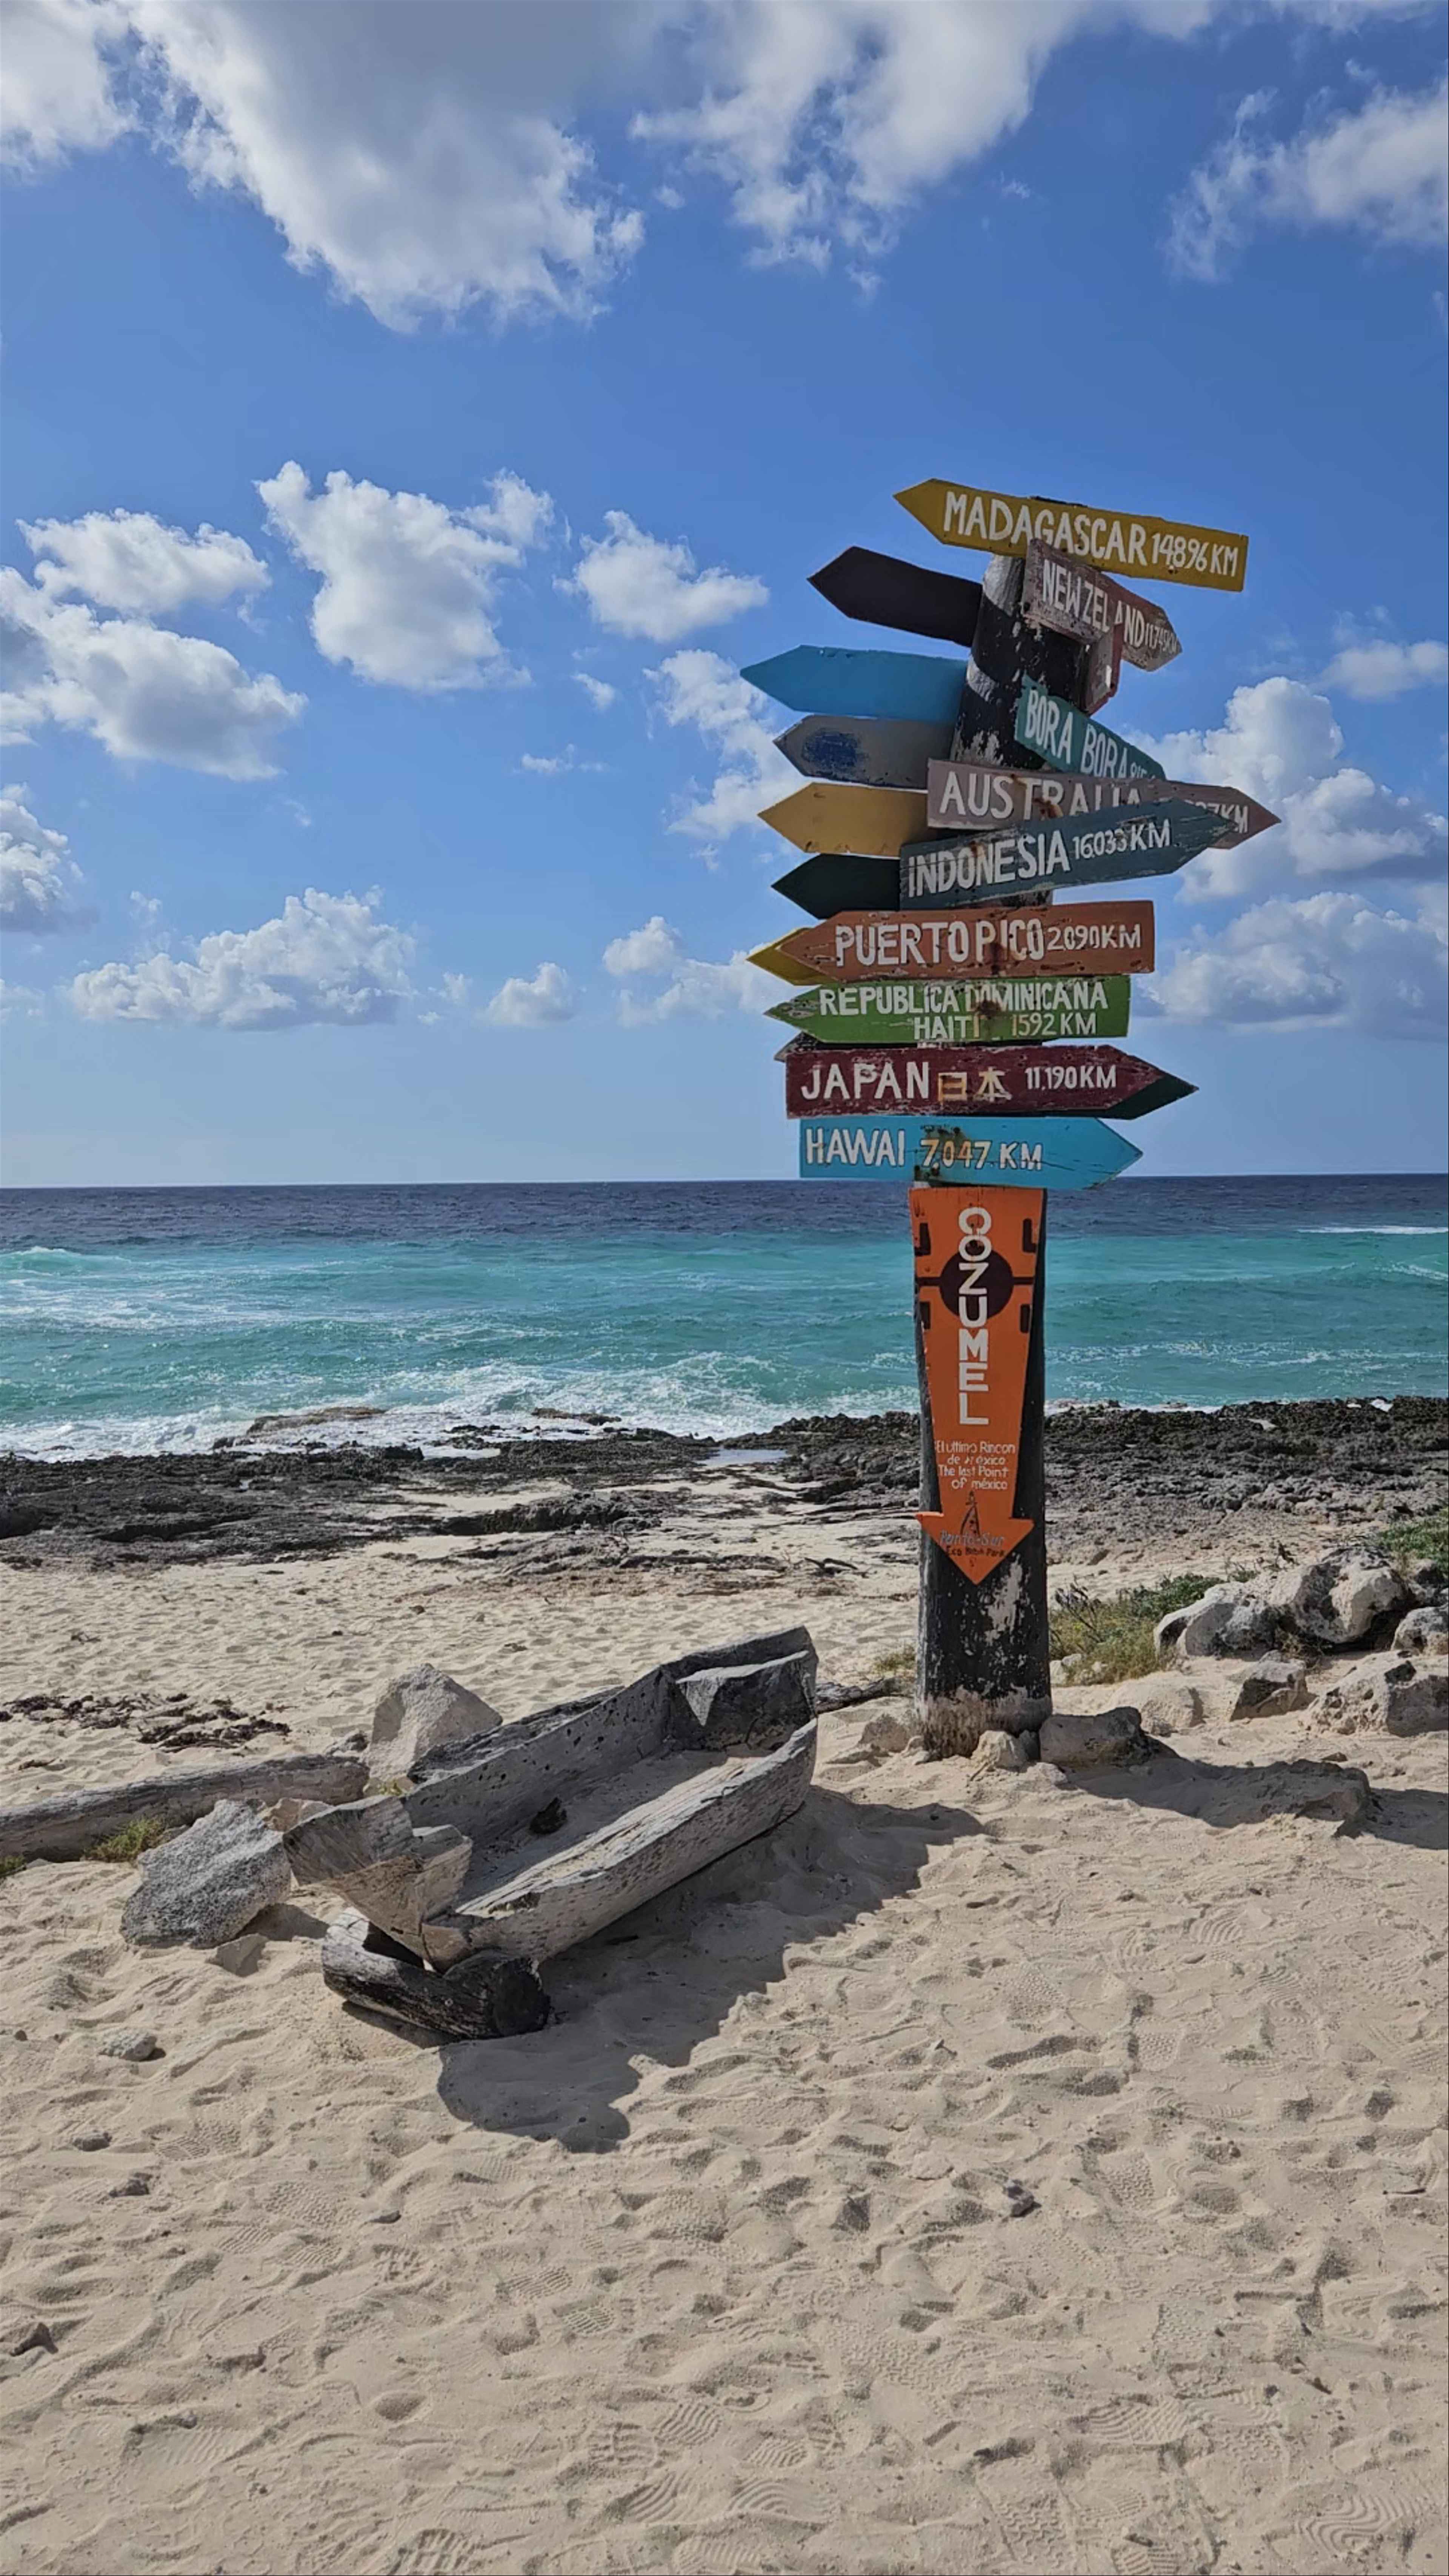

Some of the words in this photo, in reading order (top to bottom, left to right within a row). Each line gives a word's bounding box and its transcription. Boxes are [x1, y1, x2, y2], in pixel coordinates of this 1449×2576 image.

[943, 491, 1148, 566] MADAGASCAR
[1024, 689, 1073, 764] BORA
[1080, 723, 1128, 778] BORA
[908, 830, 1071, 898] INDONESIA
[835, 920, 969, 967] PUERTO
[818, 984, 960, 1016] REPUBLICA
[964, 981, 1108, 1012] DOMINICANA
[1010, 1012, 1057, 1037] 1592
[801, 1061, 929, 1101] JAPAN
[938, 1067, 1012, 1105] 日本
[805, 1127, 905, 1167] HAWAI
[999, 1142, 1042, 1170] KM
[958, 1206, 992, 1425] COZUMEL
[938, 1464, 955, 1477] The
[958, 1465, 976, 1477] last
[978, 1465, 1009, 1478] Point
[947, 1453, 961, 1465] de
